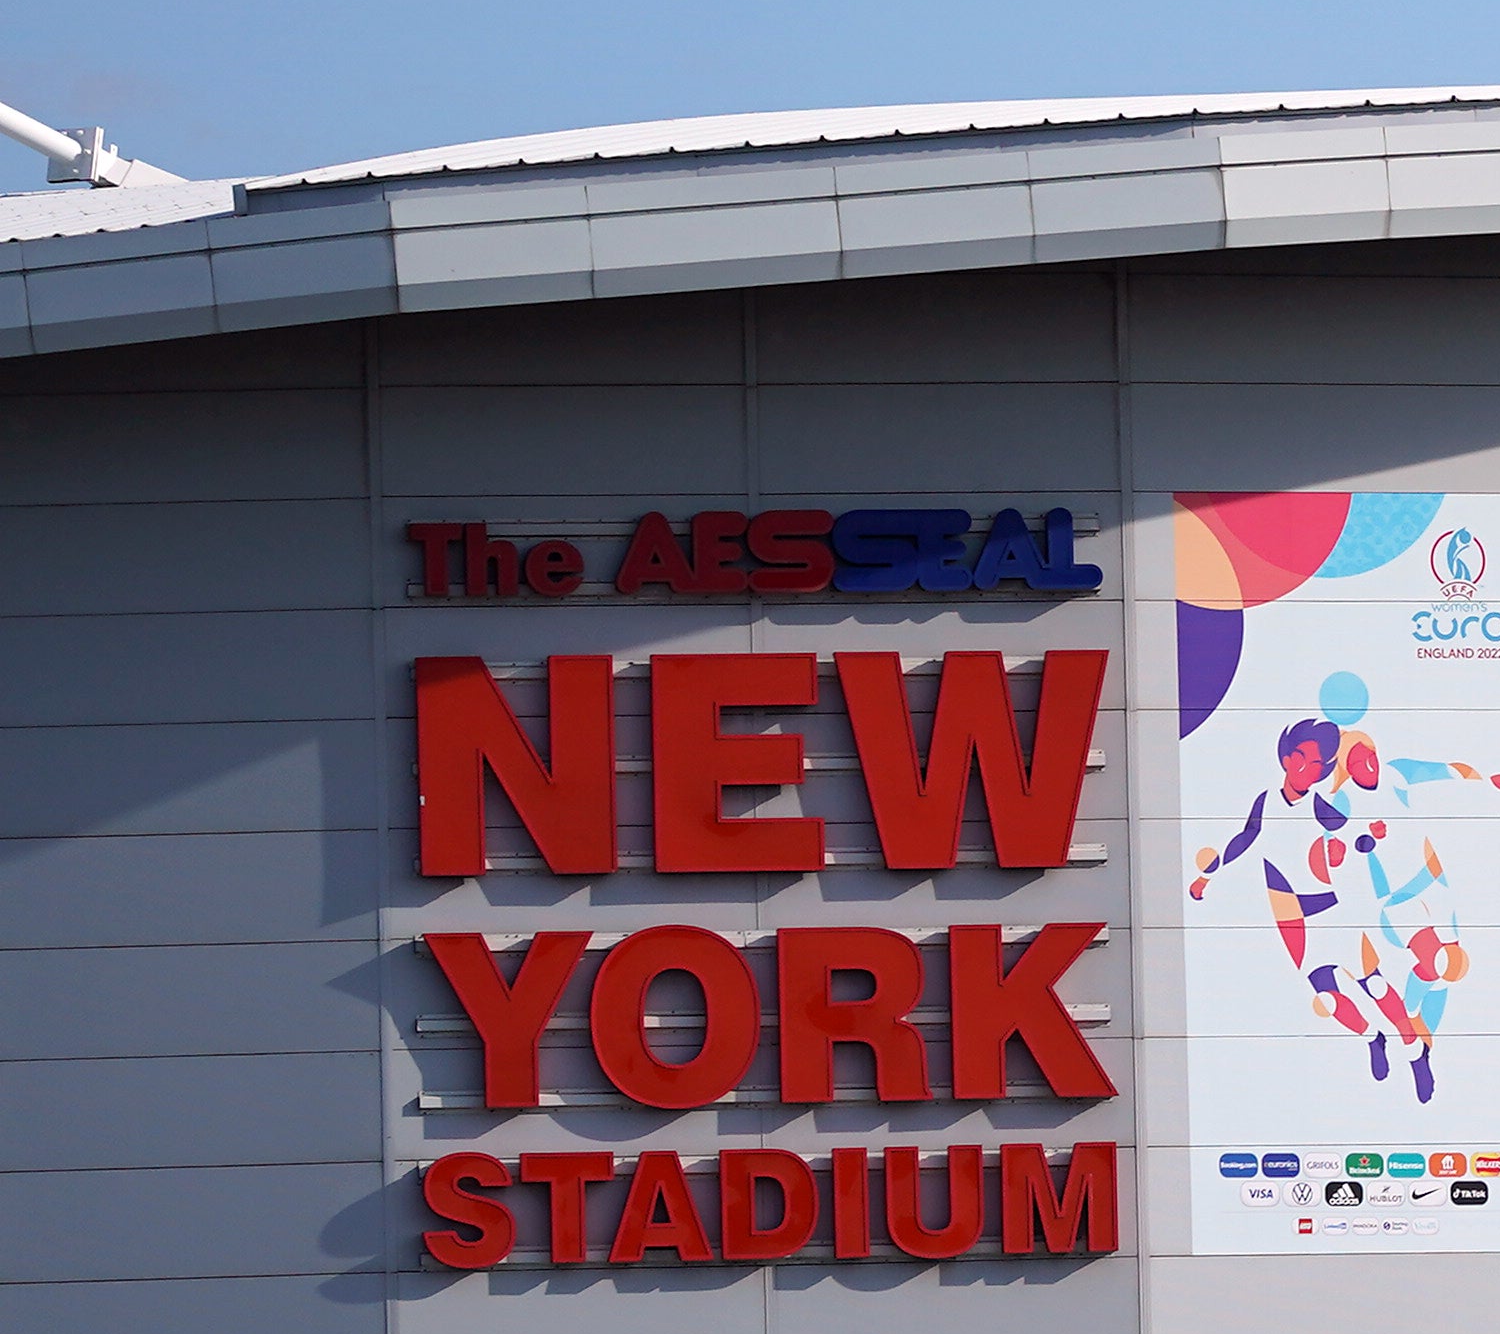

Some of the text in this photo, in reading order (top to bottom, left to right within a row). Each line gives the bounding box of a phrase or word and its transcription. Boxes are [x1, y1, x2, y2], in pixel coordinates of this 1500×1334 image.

[407, 522, 585, 597] The
[1441, 584, 1475, 598] UEFA
[1417, 647, 1475, 659] ENGLAND
[413, 649, 1110, 876] NEW
[422, 922, 1120, 1110] YORK
[1306, 1161, 1340, 1170] GRIFOLS
[1388, 1161, 1424, 1170] Hisense
[421, 1142, 1119, 1268] STADIUM
[1248, 1188, 1274, 1199] VISA
[1369, 1195, 1403, 1203] HUBLOT
